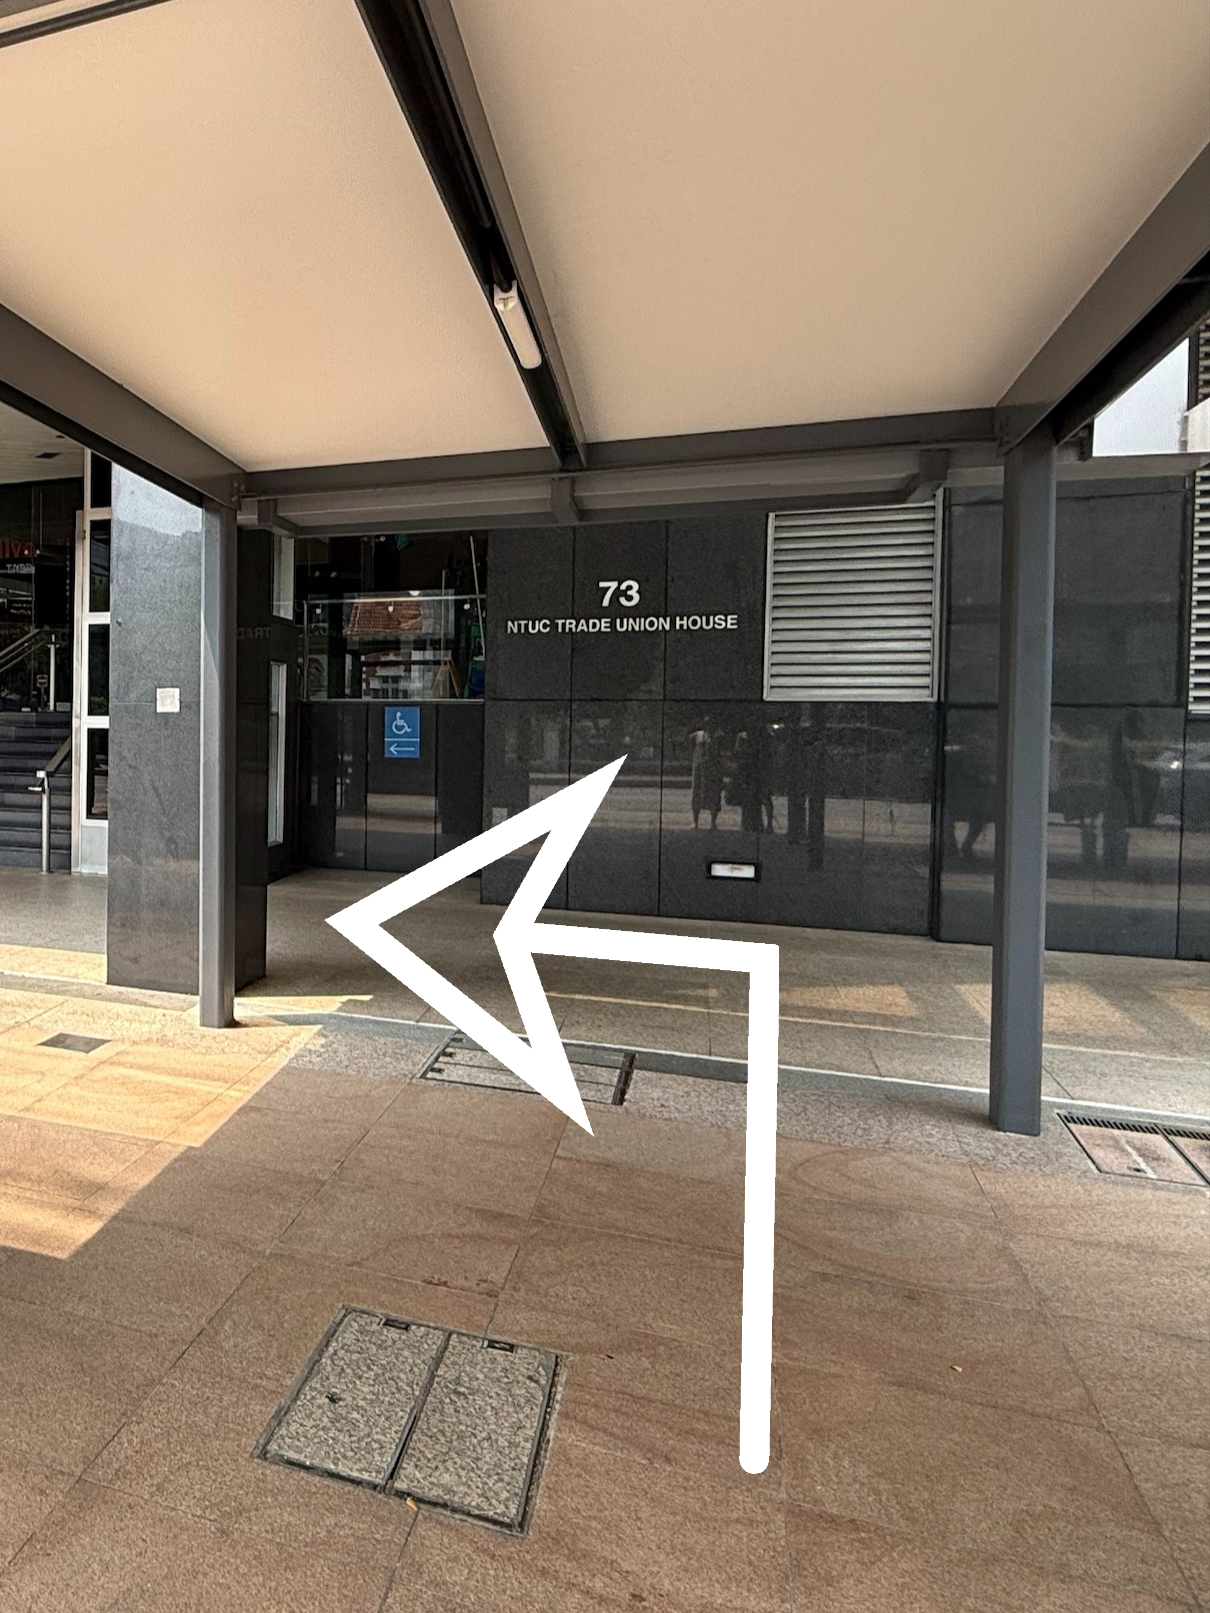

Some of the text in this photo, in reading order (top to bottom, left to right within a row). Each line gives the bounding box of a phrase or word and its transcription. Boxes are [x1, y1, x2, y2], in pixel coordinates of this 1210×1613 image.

[598, 579, 641, 607] 73
[506, 614, 739, 634] NTUC TRADE UNION HOUSE
